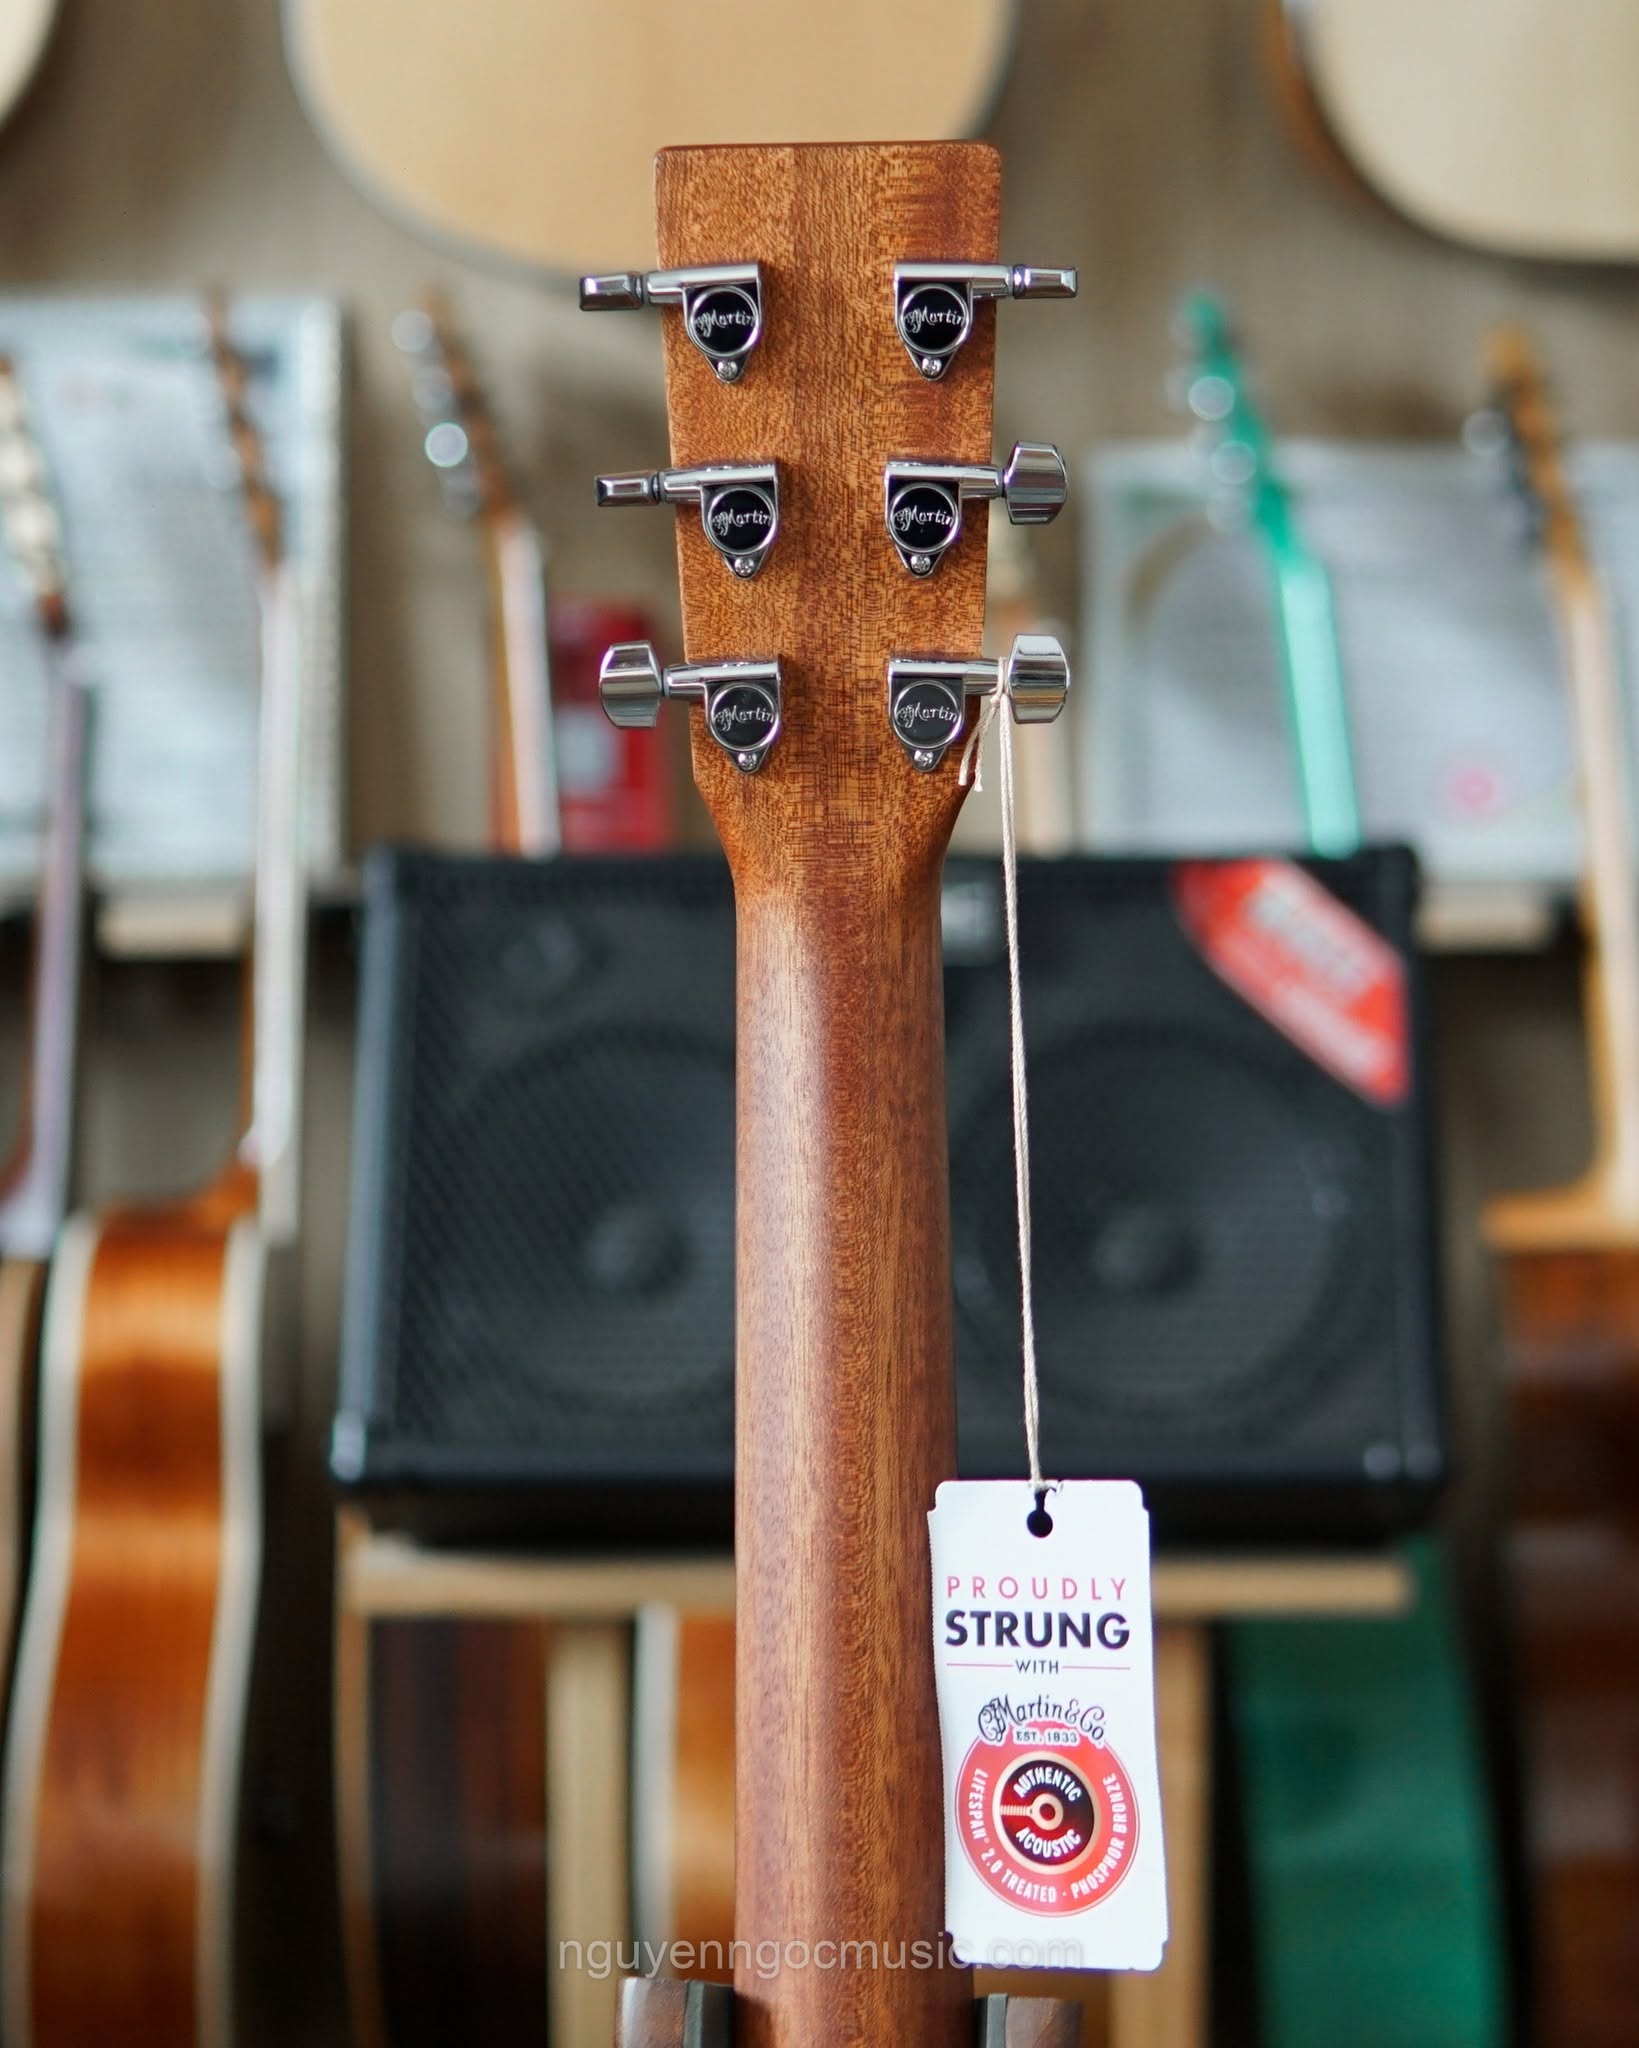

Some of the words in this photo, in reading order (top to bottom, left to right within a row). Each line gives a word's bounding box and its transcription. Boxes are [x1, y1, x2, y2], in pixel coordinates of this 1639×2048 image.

[947, 1575, 1126, 1600] PROUDLY
[945, 1609, 1130, 1650] STRUNG
[1015, 1659, 1059, 1675] WITH
[1016, 1730, 1043, 1742] EST.
[1047, 1731, 1078, 1743] 1833
[1013, 1766, 1083, 1802] AUTHENTIC
[980, 1847, 1003, 1874] 2.0
[1001, 1868, 1057, 1903] TREATED
[1070, 1837, 1126, 1899] PHOSPHOR
[1102, 1772, 1128, 1834] BRONZE
[1015, 1826, 1082, 1858] ACOUSTIC
